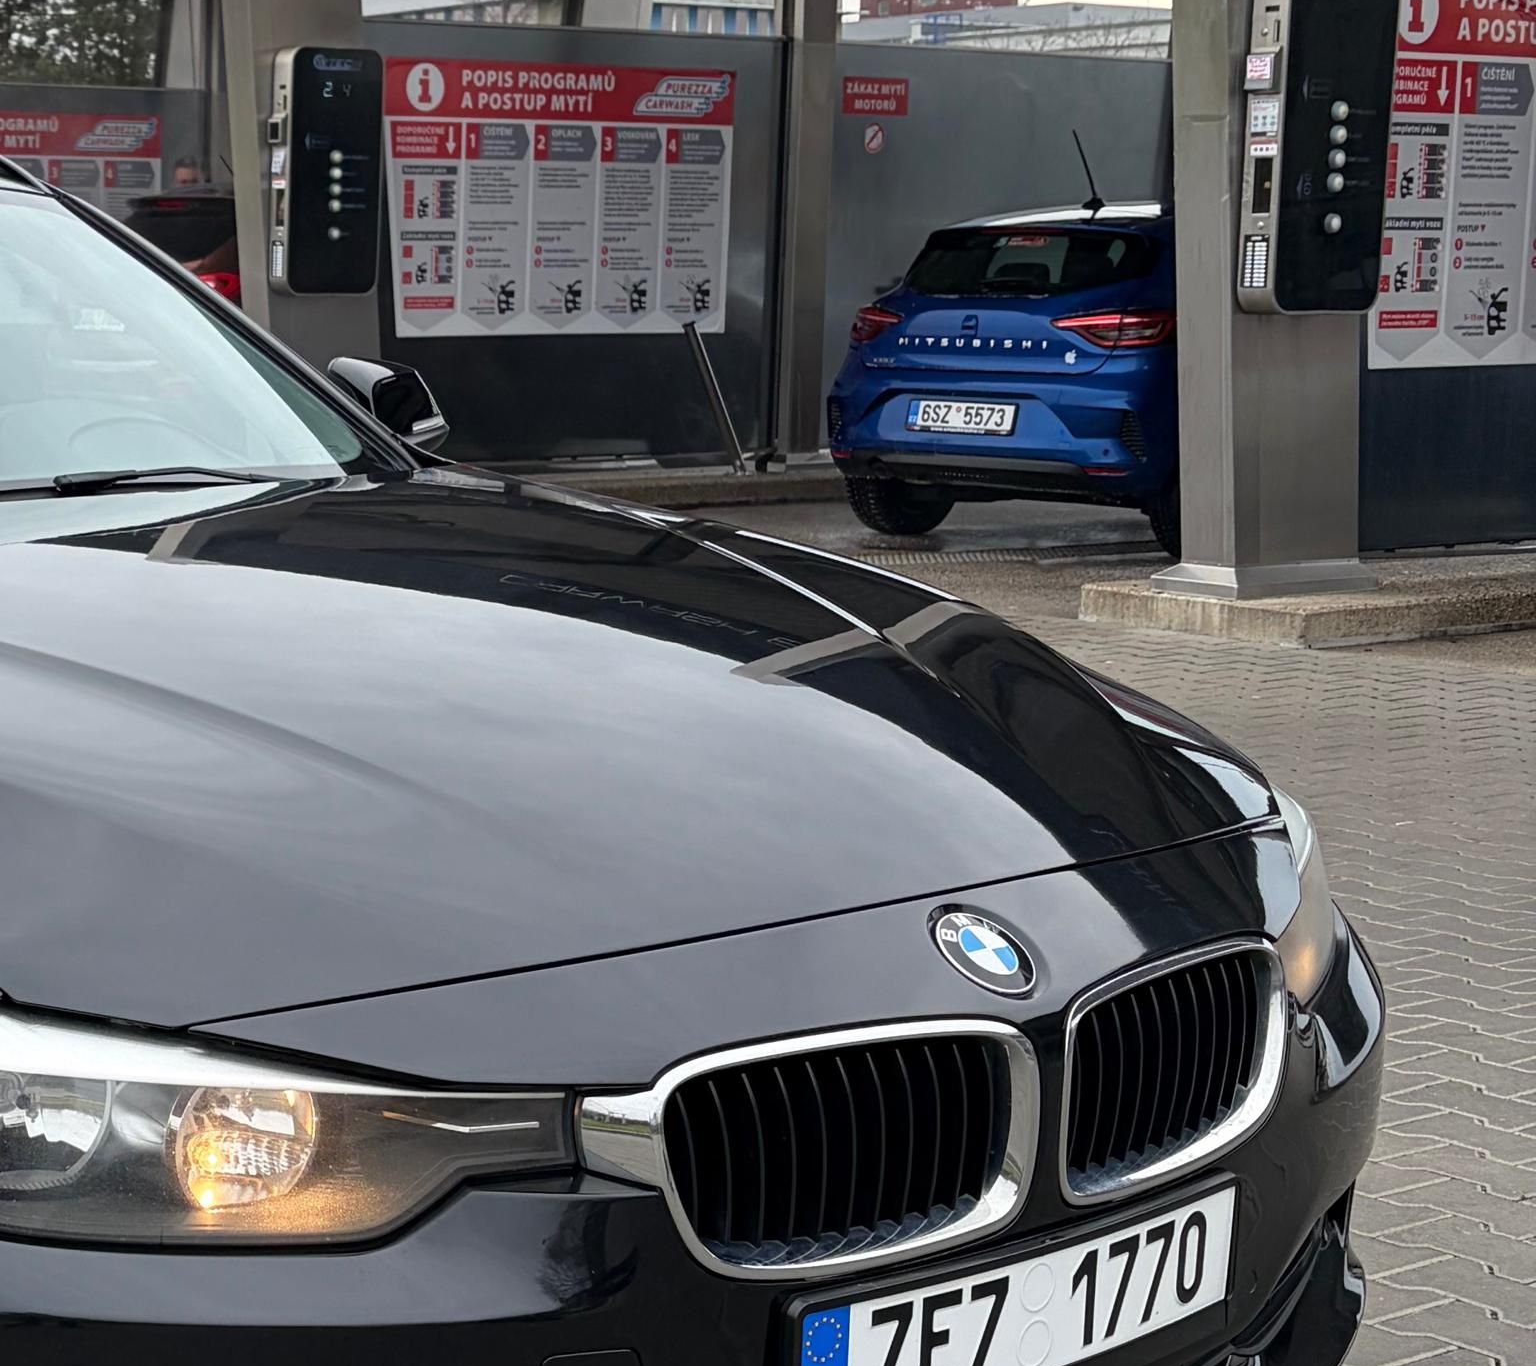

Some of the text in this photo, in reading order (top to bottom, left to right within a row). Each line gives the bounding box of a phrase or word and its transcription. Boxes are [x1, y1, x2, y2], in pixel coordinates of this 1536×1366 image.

[1457, 17, 1472, 41] A
[461, 69, 616, 92] POPIS PROGRAMŮ
[1464, 77, 1473, 98] 1
[846, 81, 906, 96] ZÁKAZ MYTÍ
[460, 92, 593, 113] A POSTUP MYTÍ
[645, 98, 694, 110] CARWASH
[854, 97, 897, 111] MOTORŮ
[3, 134, 41, 149] MYTÍ
[469, 133, 476, 149] 1
[536, 135, 546, 150] 2
[603, 137, 613, 152] 3
[668, 138, 677, 153] 4
[898, 337, 1048, 350] MITSUBISHI
[921, 403, 1006, 428] 6SZ 5573
[1070, 1210, 1207, 1350] 1770
